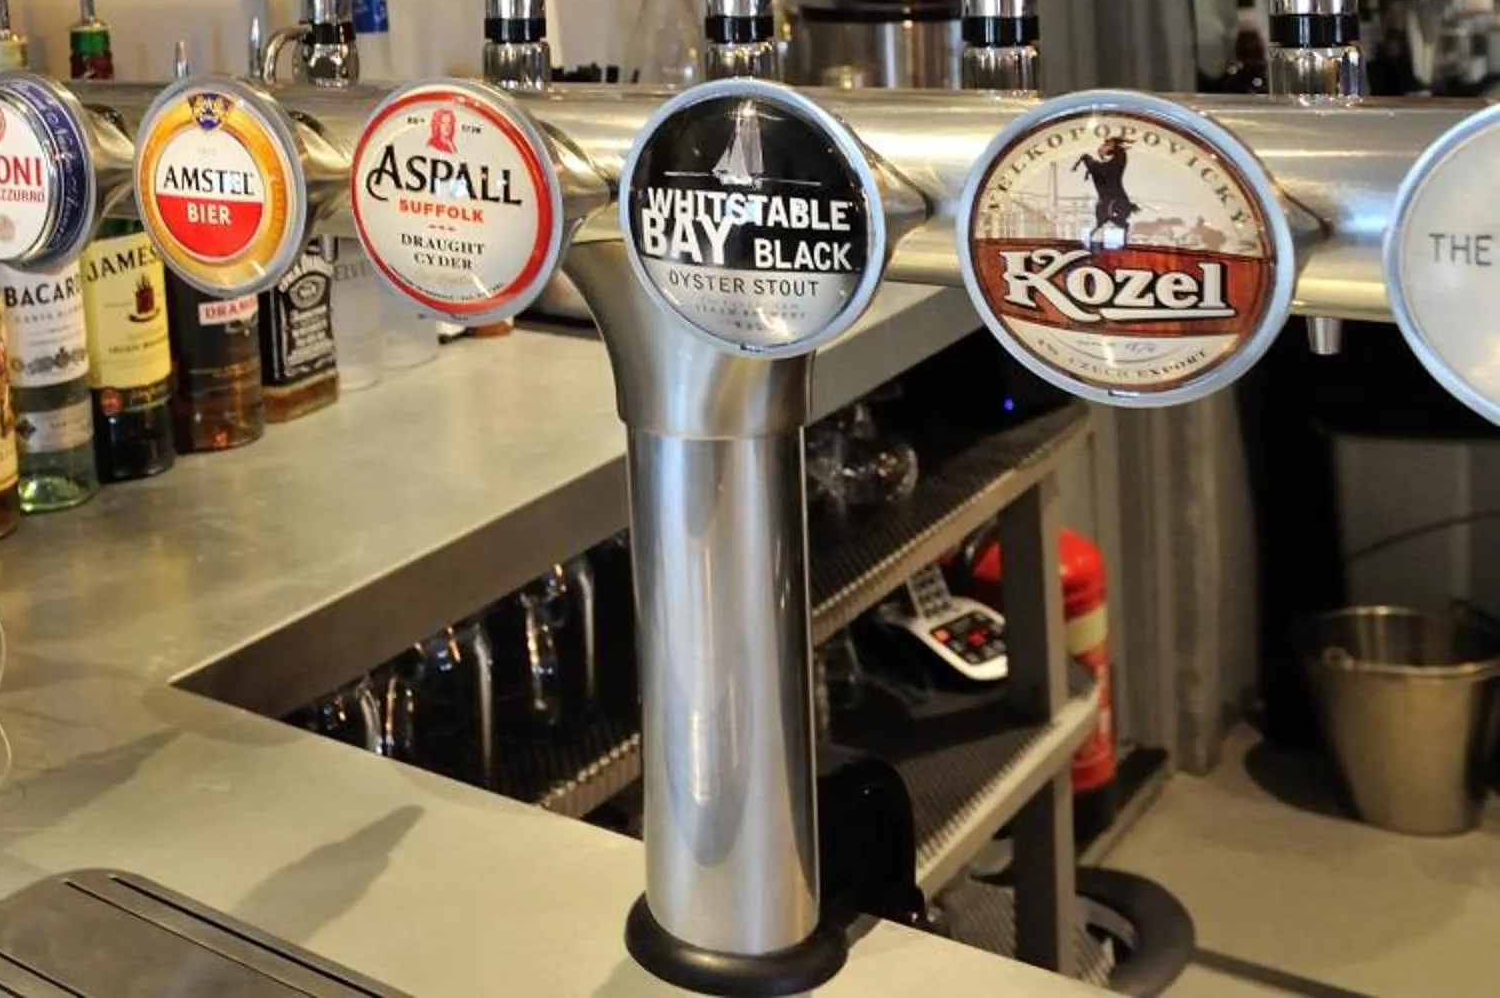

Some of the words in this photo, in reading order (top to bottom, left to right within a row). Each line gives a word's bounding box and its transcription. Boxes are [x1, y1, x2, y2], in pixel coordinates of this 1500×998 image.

[163, 164, 255, 196] AMSTEL
[366, 144, 523, 206] ASPALL
[187, 202, 232, 225] BIER
[399, 199, 485, 223] SUFFOLK
[648, 187, 852, 231] WHITSTABLE
[400, 233, 485, 256] DRAUGHT
[641, 207, 733, 266] BAY
[753, 237, 853, 271] BLACK
[1428, 232, 1493, 268] THE
[86, 245, 158, 283] JAMES
[413, 253, 473, 271] CYDER
[3, 275, 79, 308] BACAR
[668, 269, 746, 294] OYSTER
[753, 277, 820, 298] STOUT
[999, 248, 1236, 322] Kozel
